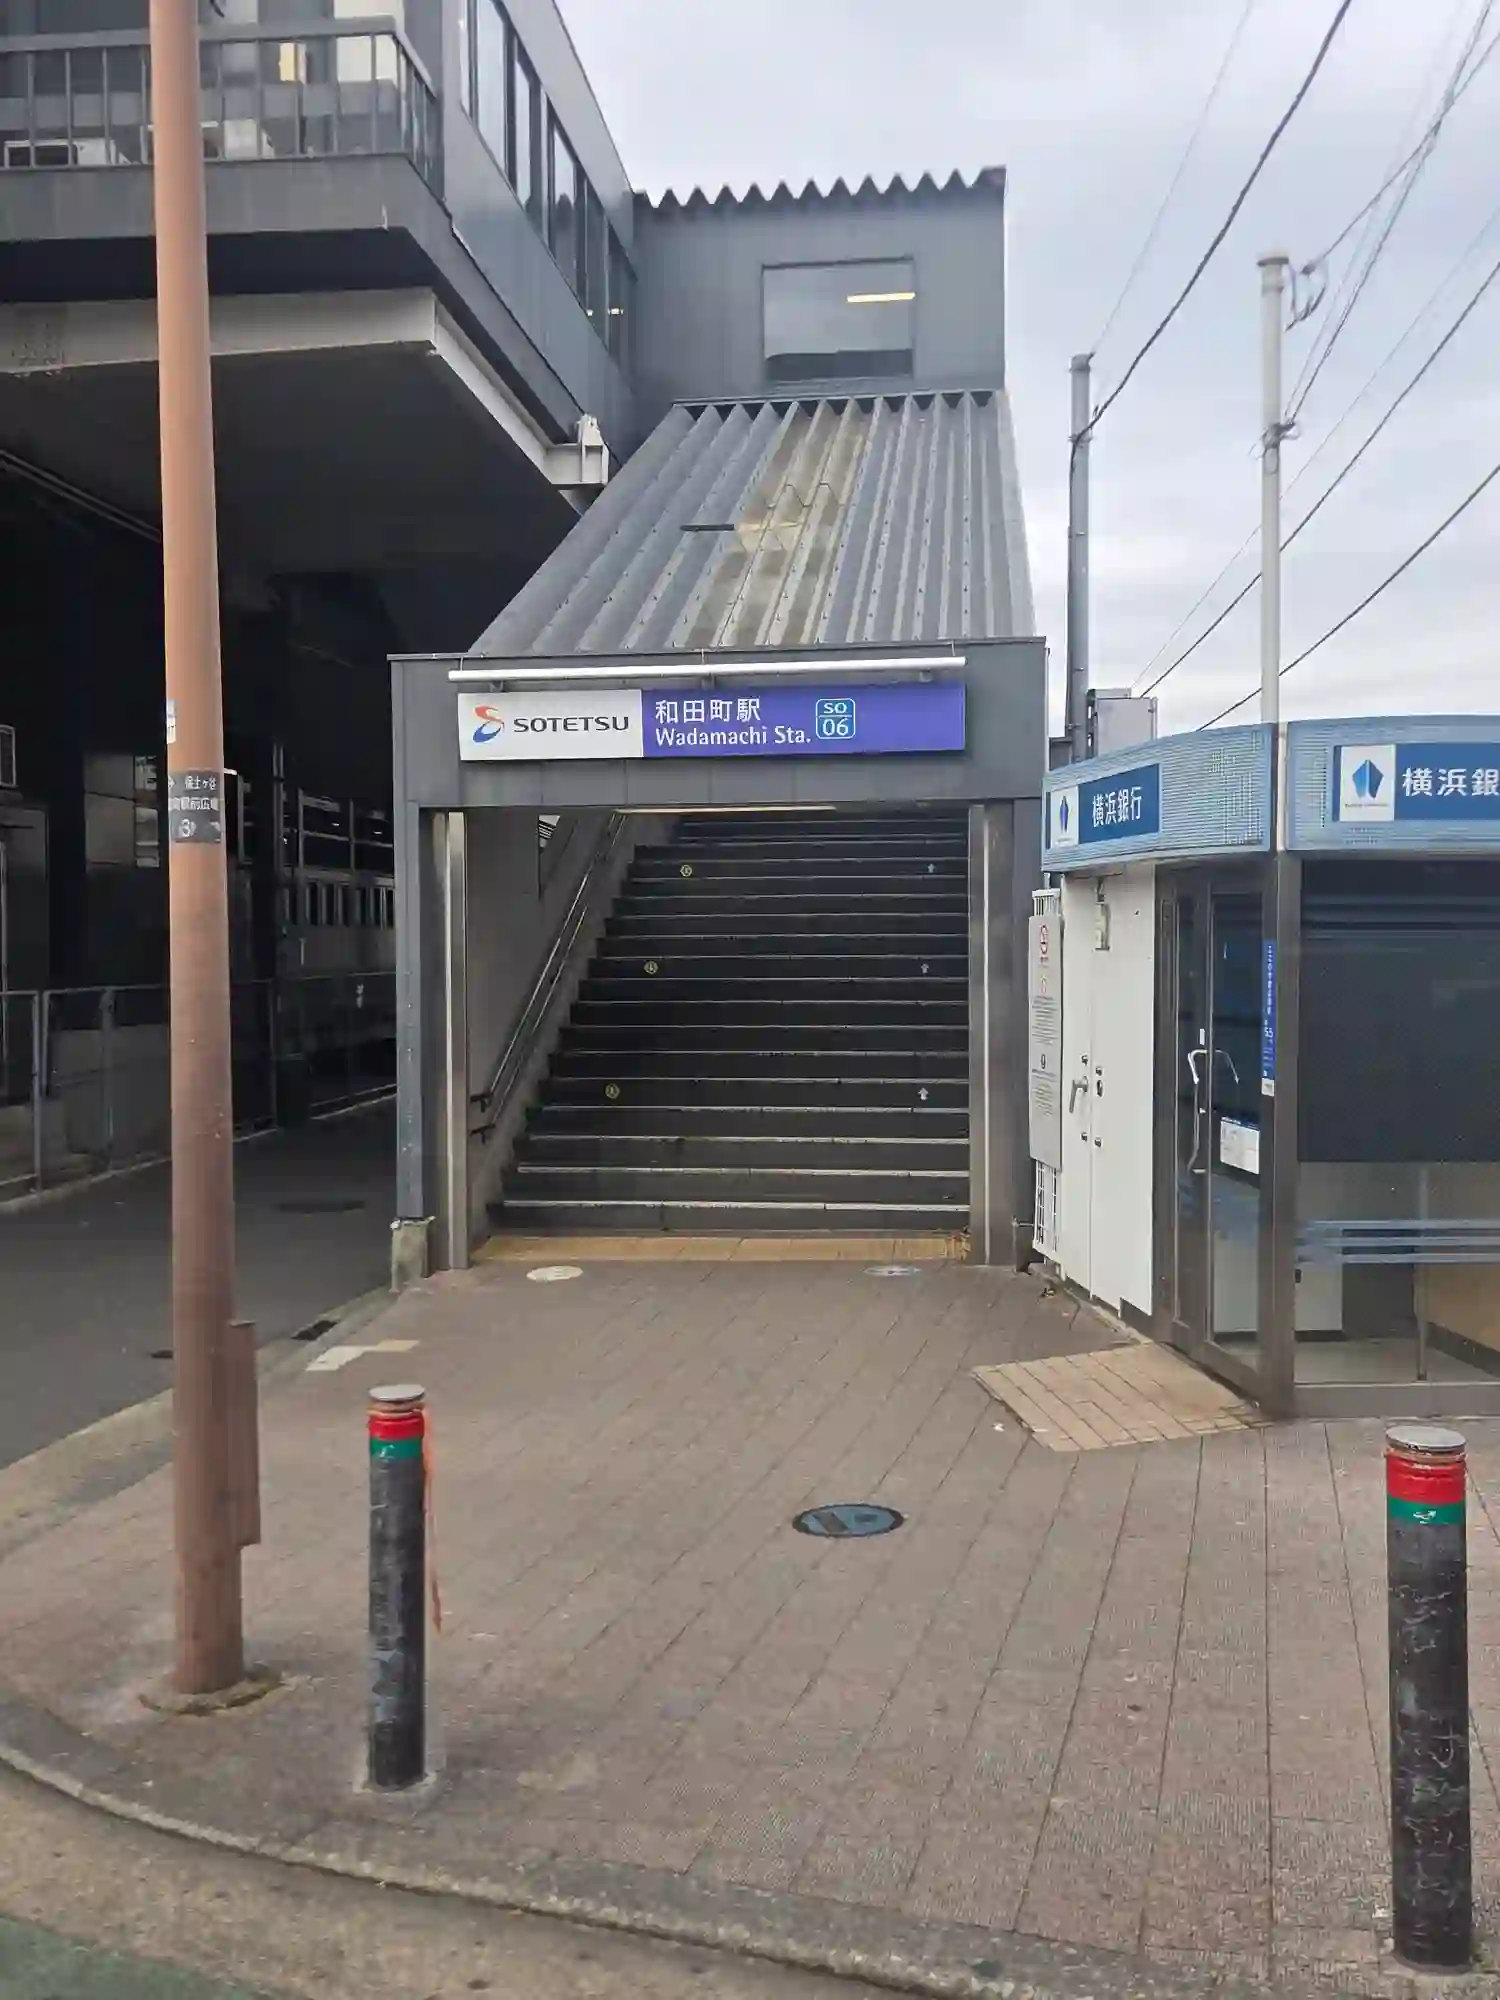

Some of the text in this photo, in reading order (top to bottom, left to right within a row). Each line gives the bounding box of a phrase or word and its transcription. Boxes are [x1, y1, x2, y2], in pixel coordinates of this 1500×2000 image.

[655, 698, 761, 724] 和田町駅
[823, 702, 848, 714] SO
[513, 716, 629, 733] SOTETSU
[822, 718, 849, 736] 06
[655, 725, 811, 746] Wadamachi Sta.
[1092, 785, 1143, 828] 横浜銀行
